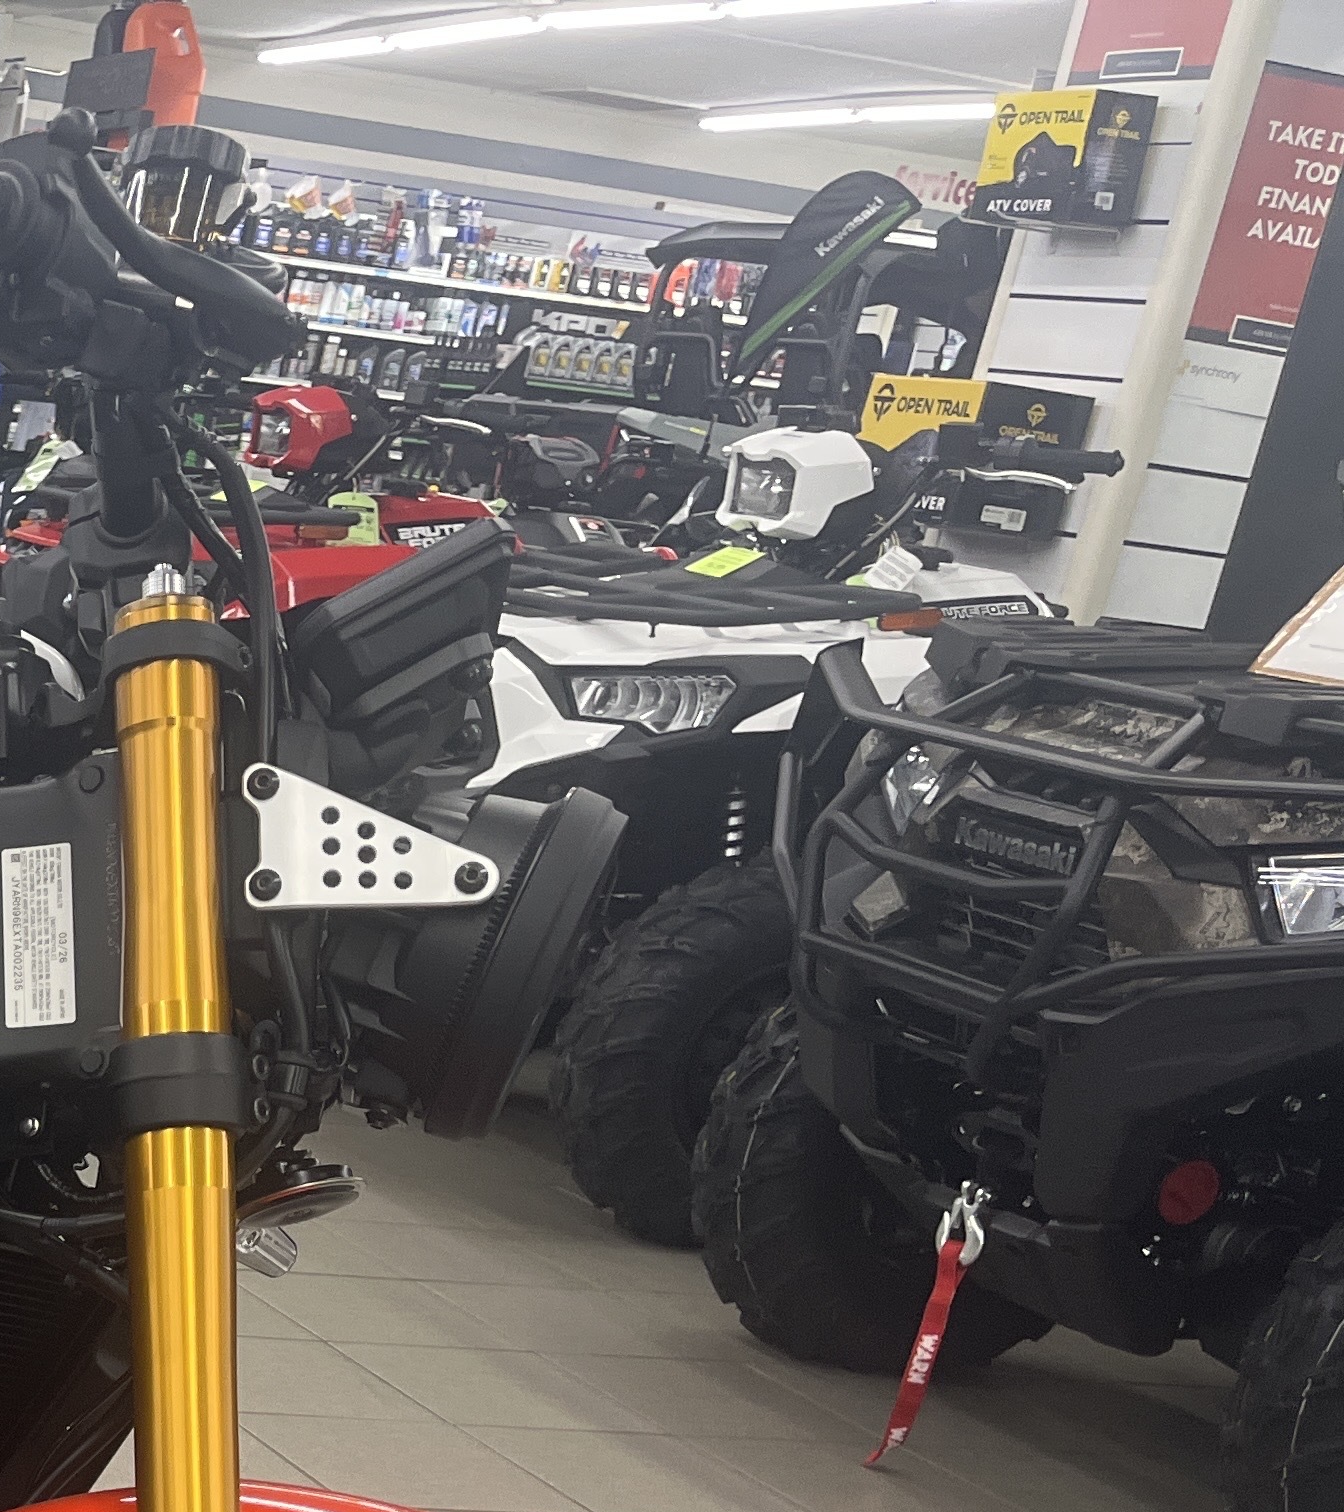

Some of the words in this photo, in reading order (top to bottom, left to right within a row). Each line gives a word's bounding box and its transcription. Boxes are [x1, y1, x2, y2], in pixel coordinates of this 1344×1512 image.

[1019, 110, 1050, 126] OPEN
[1053, 109, 1085, 124] TRAIL
[1268, 120, 1326, 151] TAKE
[986, 199, 1012, 213] ATV
[1012, 199, 1053, 212] COVER
[814, 195, 886, 257] Kawasaki
[1190, 363, 1242, 384] synchrony
[896, 396, 936, 416] OPEN
[937, 398, 971, 418] TRAIL
[977, 602, 1029, 616] FORCE
[954, 816, 1077, 877] Kawasaki
[907, 1334, 939, 1385] WARN
